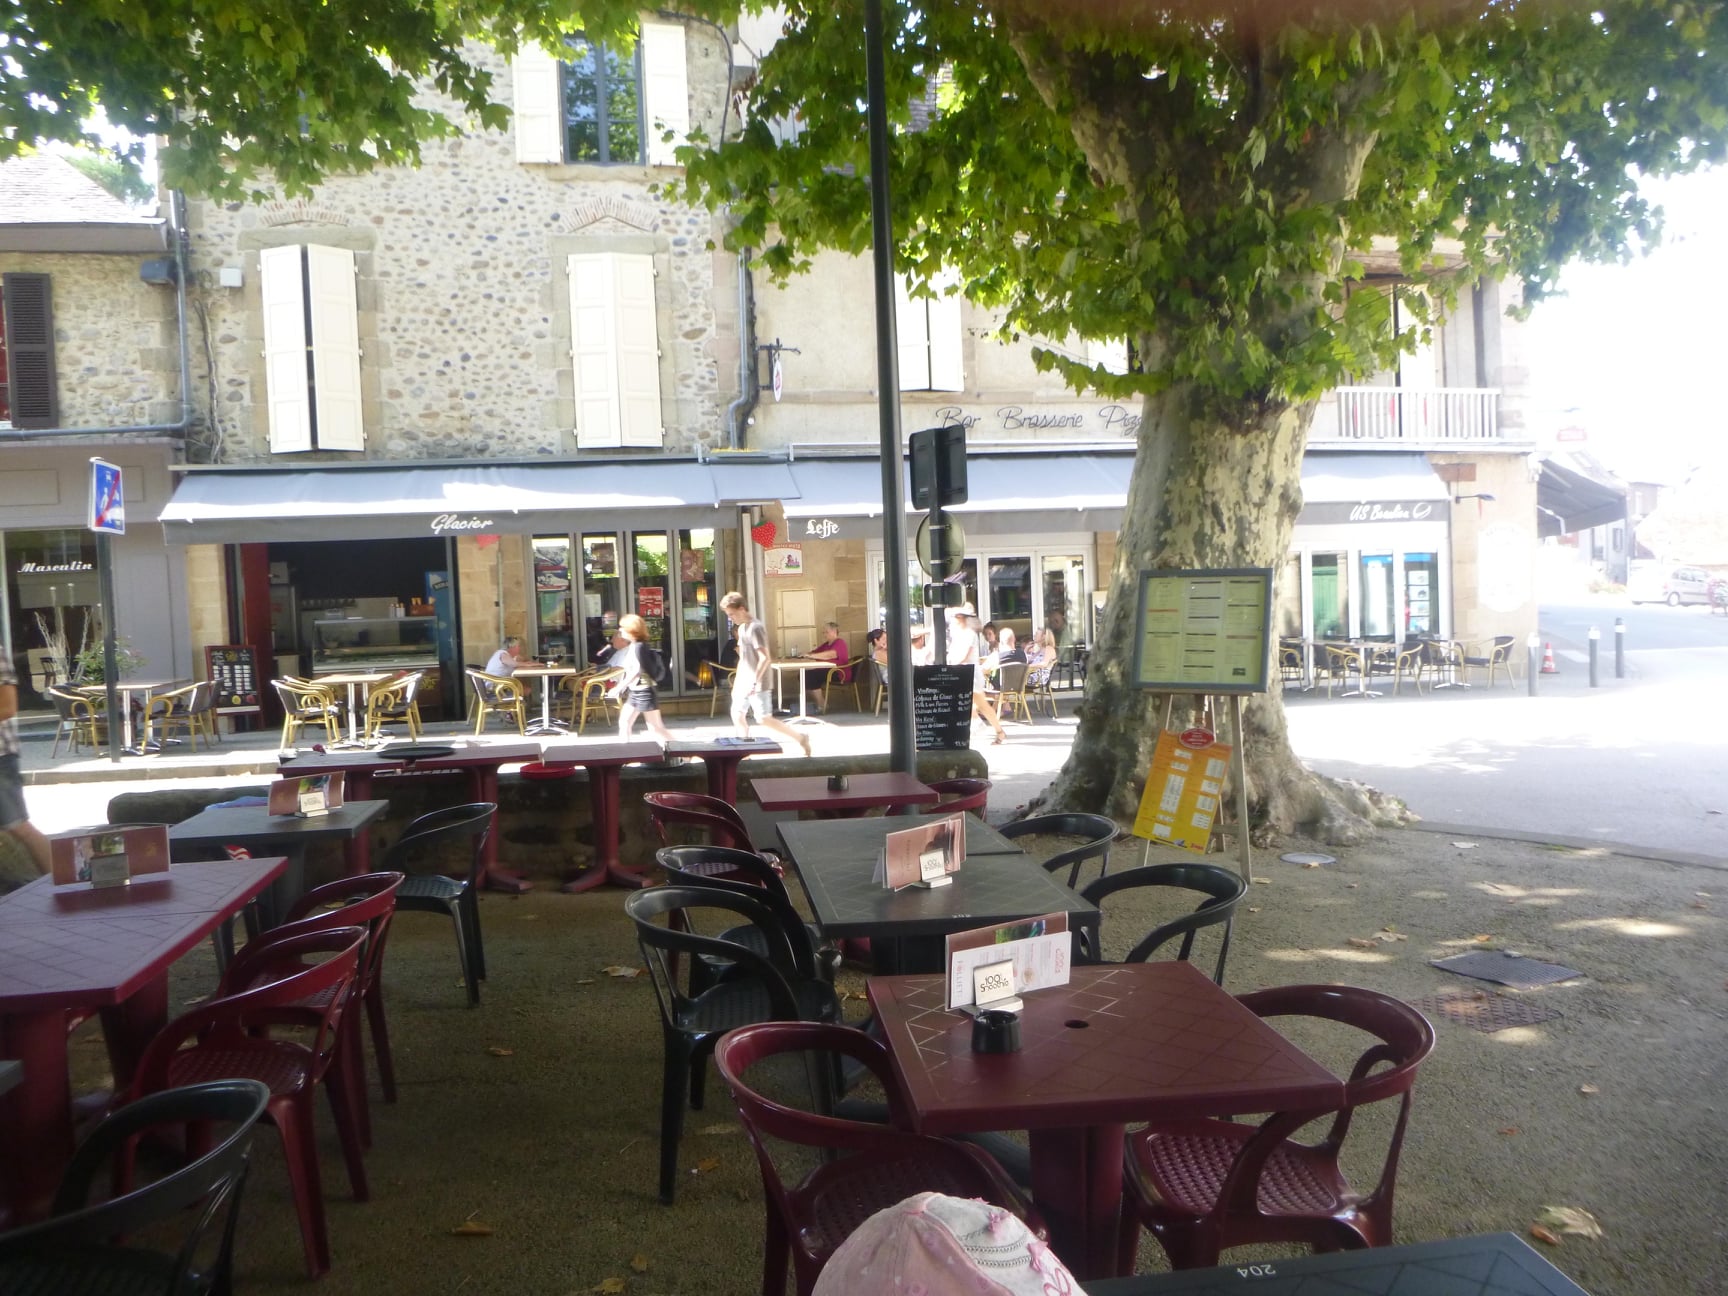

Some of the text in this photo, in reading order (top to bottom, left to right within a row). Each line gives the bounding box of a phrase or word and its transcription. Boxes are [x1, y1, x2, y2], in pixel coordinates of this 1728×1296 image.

[935, 406, 981, 429] Bar
[997, 405, 1084, 430] Brasserie
[1349, 504, 1371, 521] US
[430, 514, 494, 535] Glacier
[805, 519, 840, 539] Leffe
[17, 561, 94, 573] Masculin
[1237, 1264, 1276, 1278] 204
